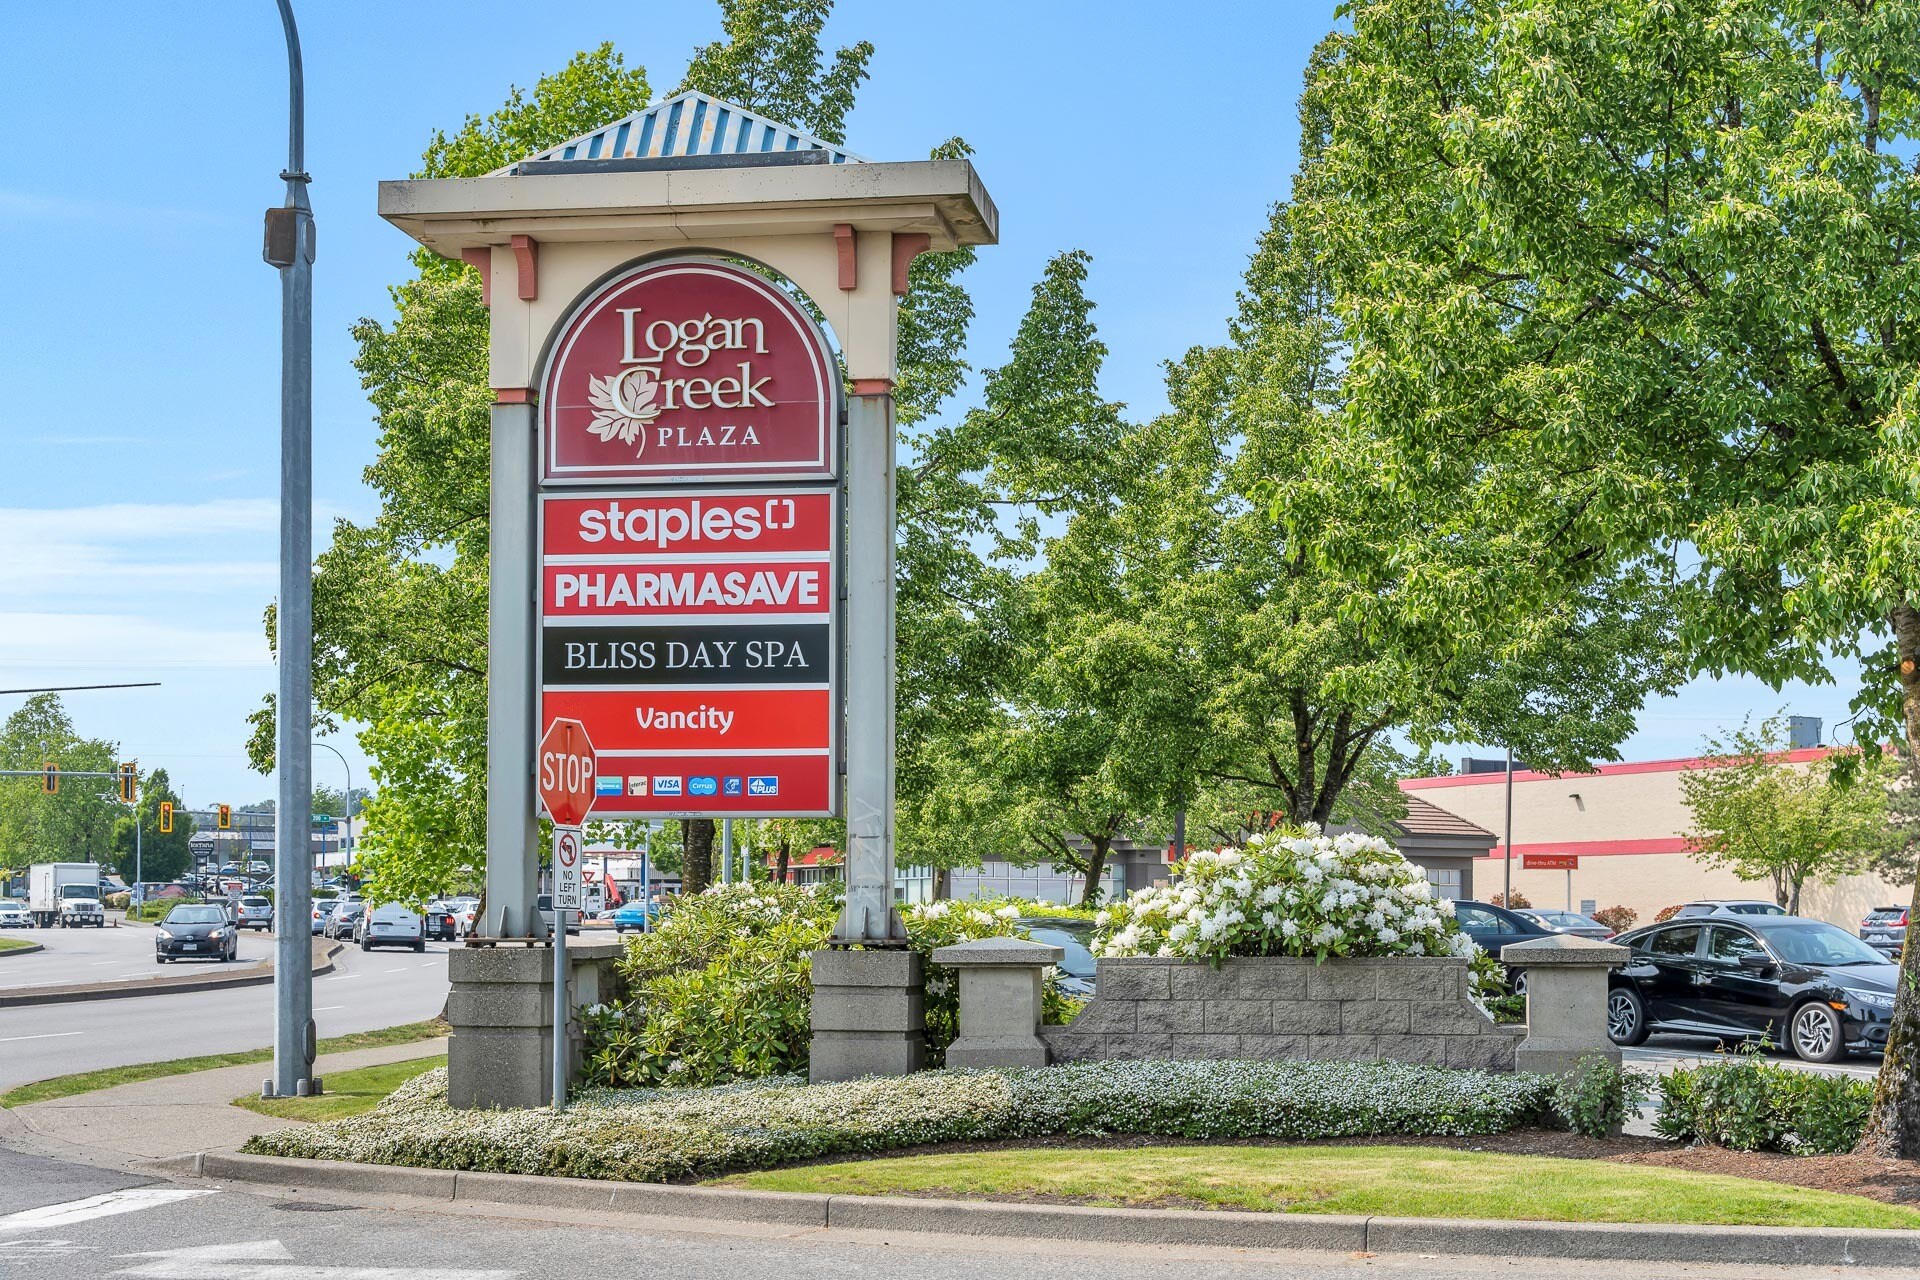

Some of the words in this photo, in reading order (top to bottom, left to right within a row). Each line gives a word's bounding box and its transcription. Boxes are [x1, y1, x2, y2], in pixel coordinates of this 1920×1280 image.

[615, 307, 770, 367] Logan
[611, 361, 776, 420] Creek
[656, 425, 761, 448] PLAZA
[578, 500, 762, 549] staples
[555, 570, 819, 608] PHARMASAVE
[564, 641, 656, 669] BLISS
[665, 641, 737, 669] DAY
[745, 640, 810, 668] SPA
[635, 704, 735, 735] Vancity
[542, 751, 593, 794] STOP
[657, 779, 680, 789] VISA
[757, 785, 777, 794] PLUS
[559, 882, 576, 892] LEFT
[562, 870, 573, 880] NO
[558, 894, 577, 905] TURN
